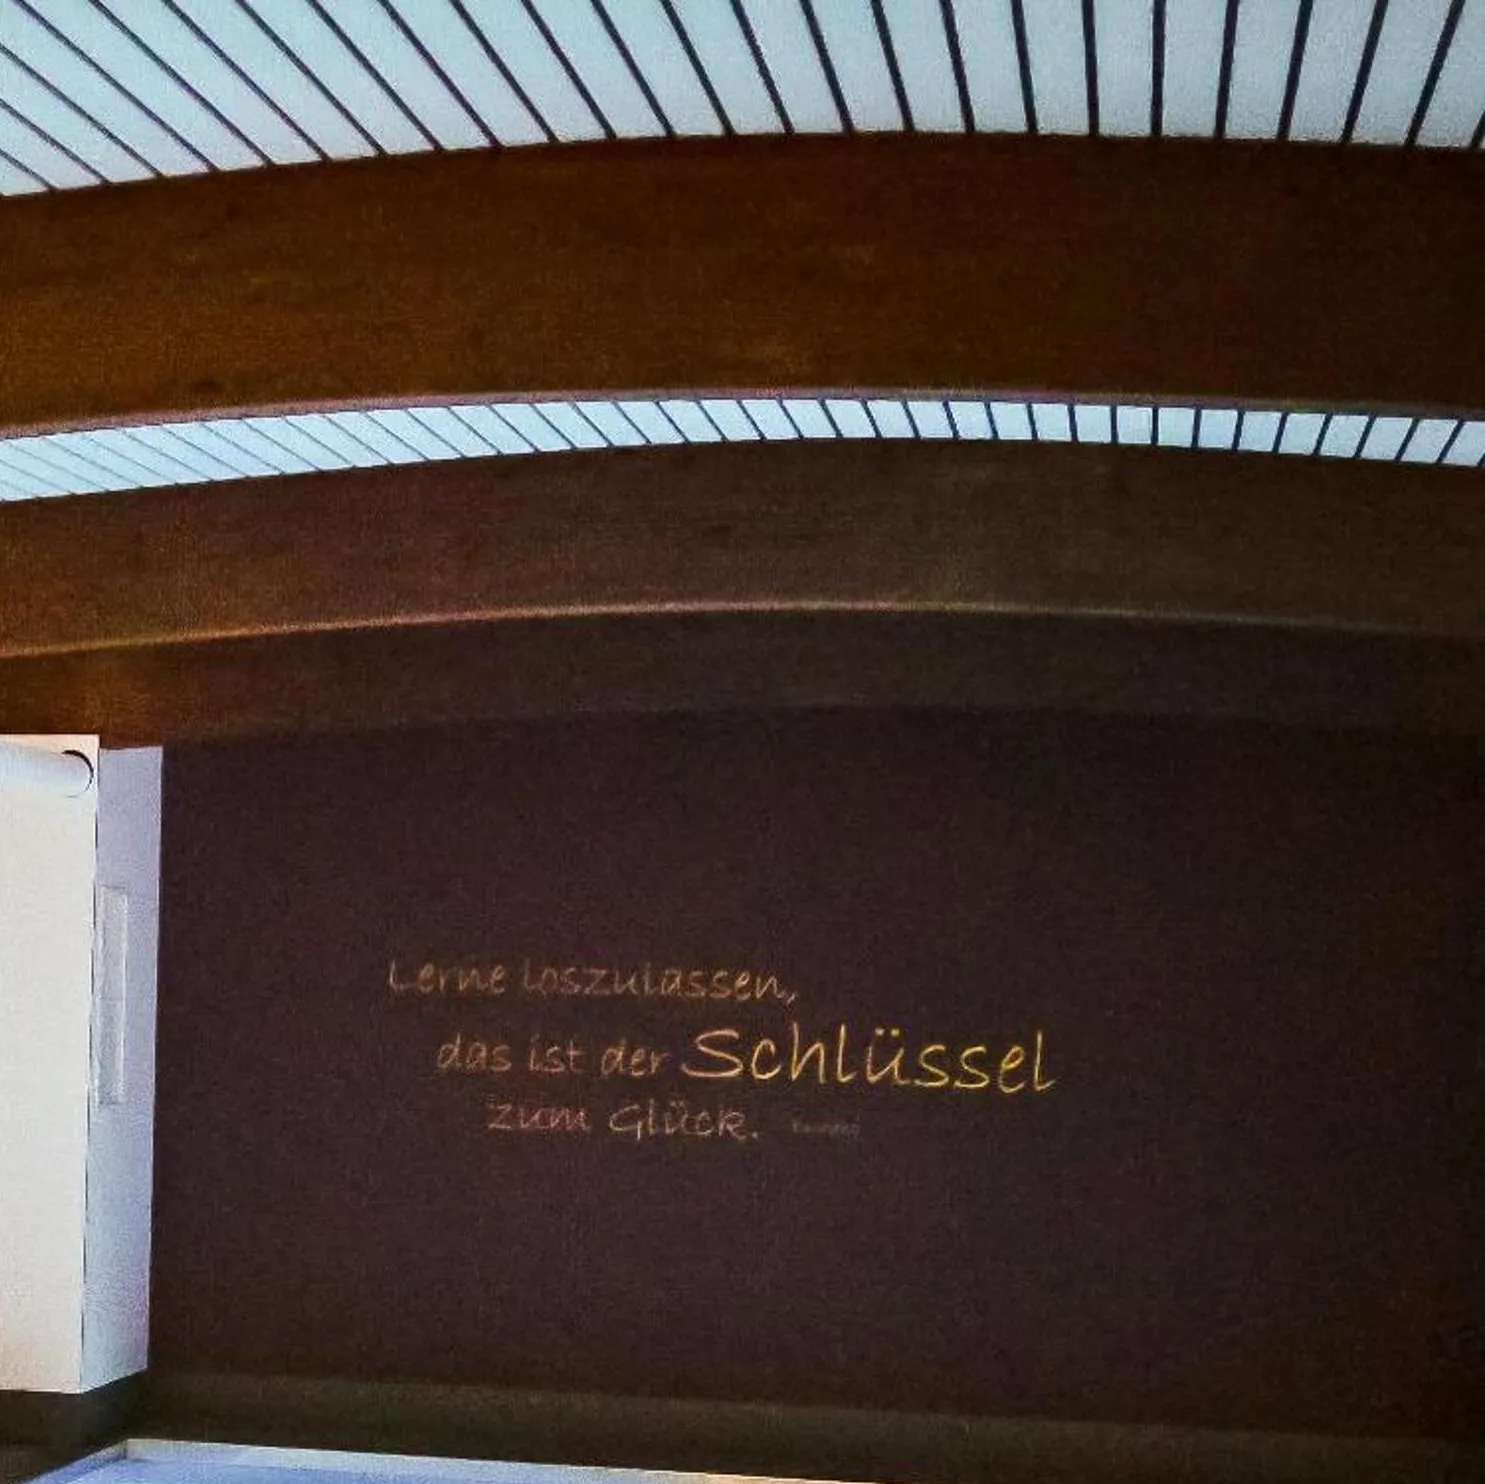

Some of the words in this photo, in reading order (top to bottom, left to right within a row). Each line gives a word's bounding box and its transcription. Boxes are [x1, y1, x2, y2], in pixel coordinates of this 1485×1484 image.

[388, 958, 506, 997] Lerne
[520, 957, 797, 1008] loszulassen,
[435, 1032, 512, 1075] das
[527, 1032, 580, 1077] ist
[599, 1034, 669, 1078] der
[680, 1021, 1058, 1094] Schlüssel
[608, 1092, 759, 1141] Glück.
